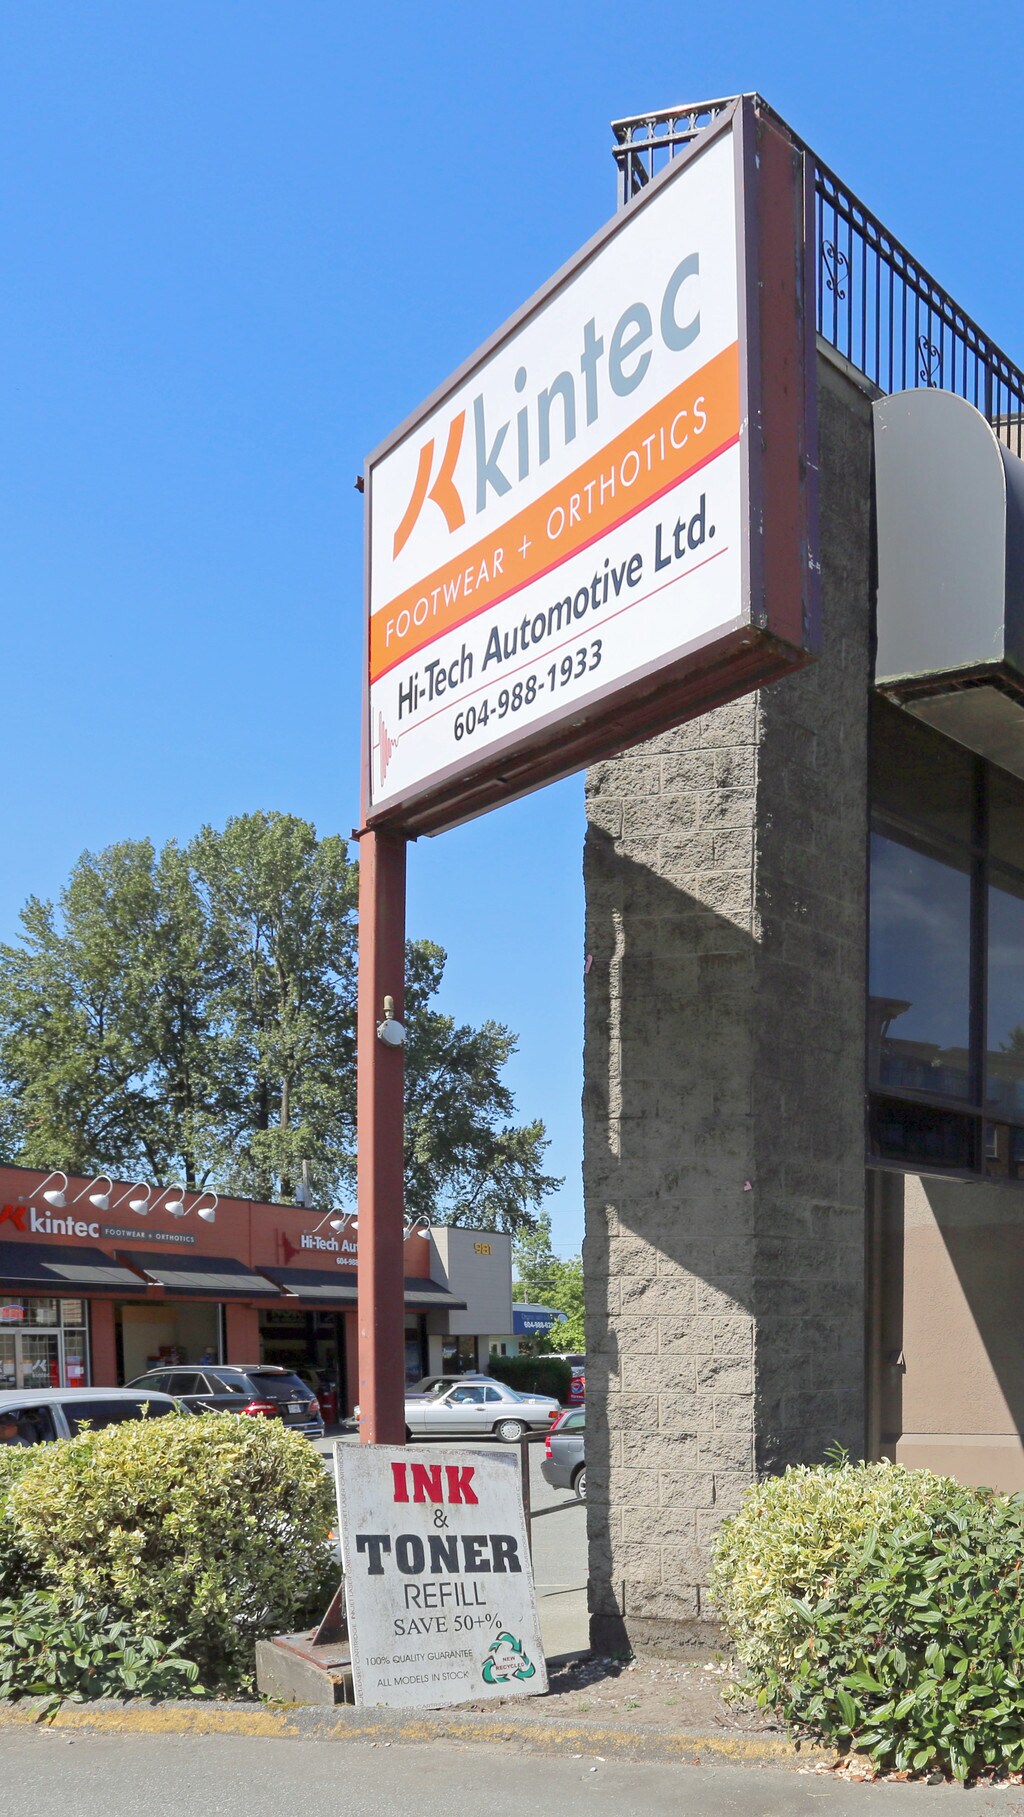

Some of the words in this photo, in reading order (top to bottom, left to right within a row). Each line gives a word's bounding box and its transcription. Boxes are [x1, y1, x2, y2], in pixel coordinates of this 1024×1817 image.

[385, 548, 504, 647] FOOTWEAR
[546, 396, 708, 540] ORTHOTICS
[397, 644, 473, 721] Hi-Tech
[482, 552, 643, 672] Automotive
[655, 493, 716, 573] Ltd.
[453, 639, 603, 741] 604-988-1933
[30, 1207, 99, 1238] kintec
[105, 1228, 145, 1239] FOOTWEAR
[155, 1233, 195, 1244] ORTHOTICS
[301, 1235, 338, 1251] Hi-Tech
[474, 1242, 492, 1255] 981
[391, 1462, 478, 1504] INK
[433, 1509, 449, 1529] &
[356, 1534, 522, 1575] TONER
[404, 1582, 486, 1609] REFILL
[394, 1616, 449, 1636] SAVE
[454, 1613, 502, 1632] 50+%
[365, 1656, 391, 1666] 100%
[392, 1653, 425, 1664] QUALITY
[427, 1649, 473, 1660] GUARANTEE
[495, 1662, 525, 1671] RECYCLED
[377, 1678, 391, 1687] ALL
[394, 1674, 429, 1686] MODELS
[432, 1673, 440, 1681] IN
[442, 1671, 469, 1681] STOCK
